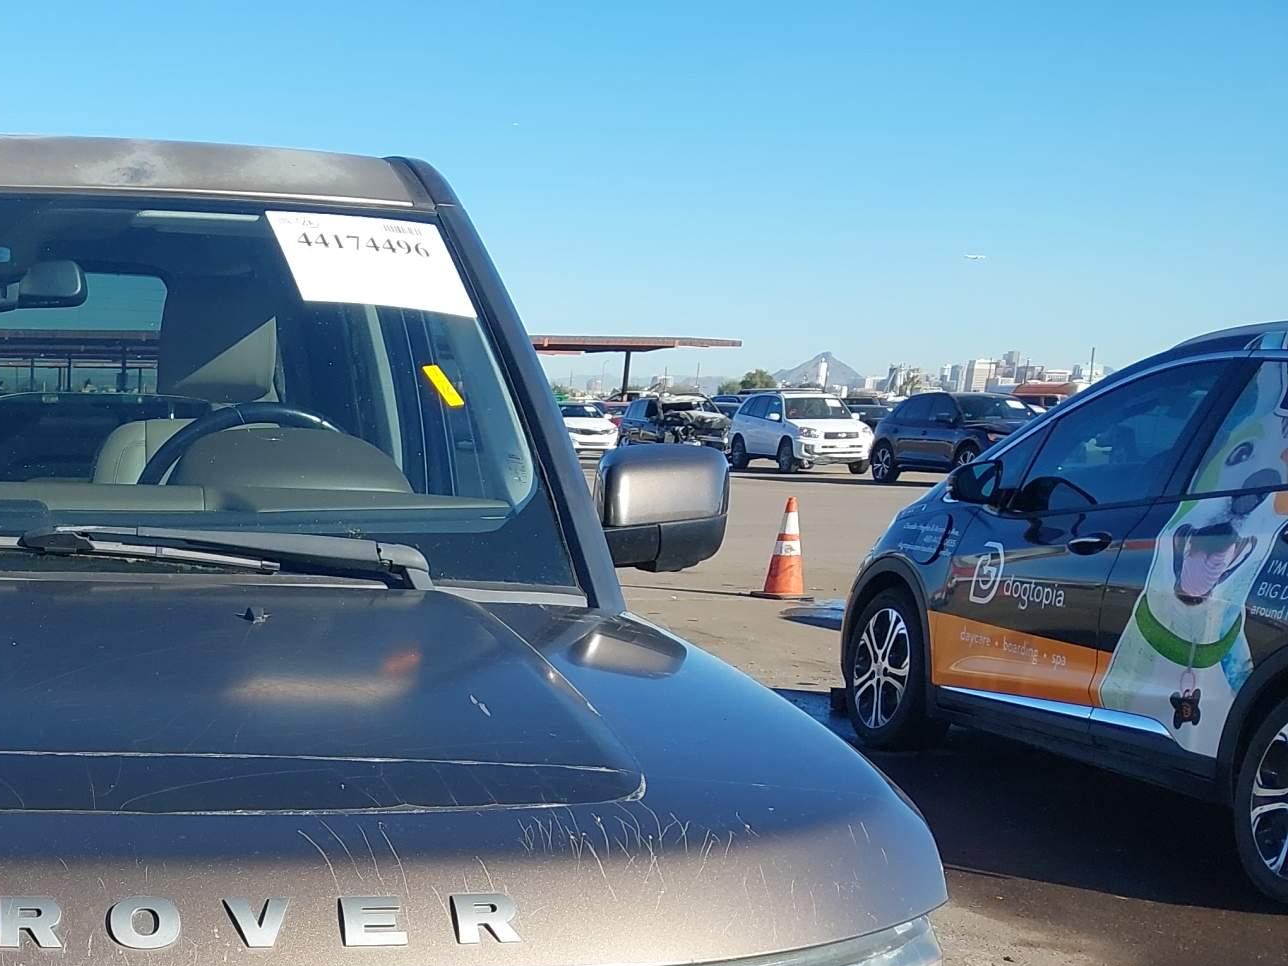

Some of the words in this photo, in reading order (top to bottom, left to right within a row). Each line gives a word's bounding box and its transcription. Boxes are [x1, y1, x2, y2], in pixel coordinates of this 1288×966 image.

[297, 232, 430, 257] 44174496
[1003, 575, 1065, 610] dogtopia
[1257, 582, 1281, 598] BIG
[1251, 605, 1286, 620] around
[960, 626, 992, 648] daycare
[1003, 637, 1039, 665] boarding
[1051, 654, 1067, 671] spa
